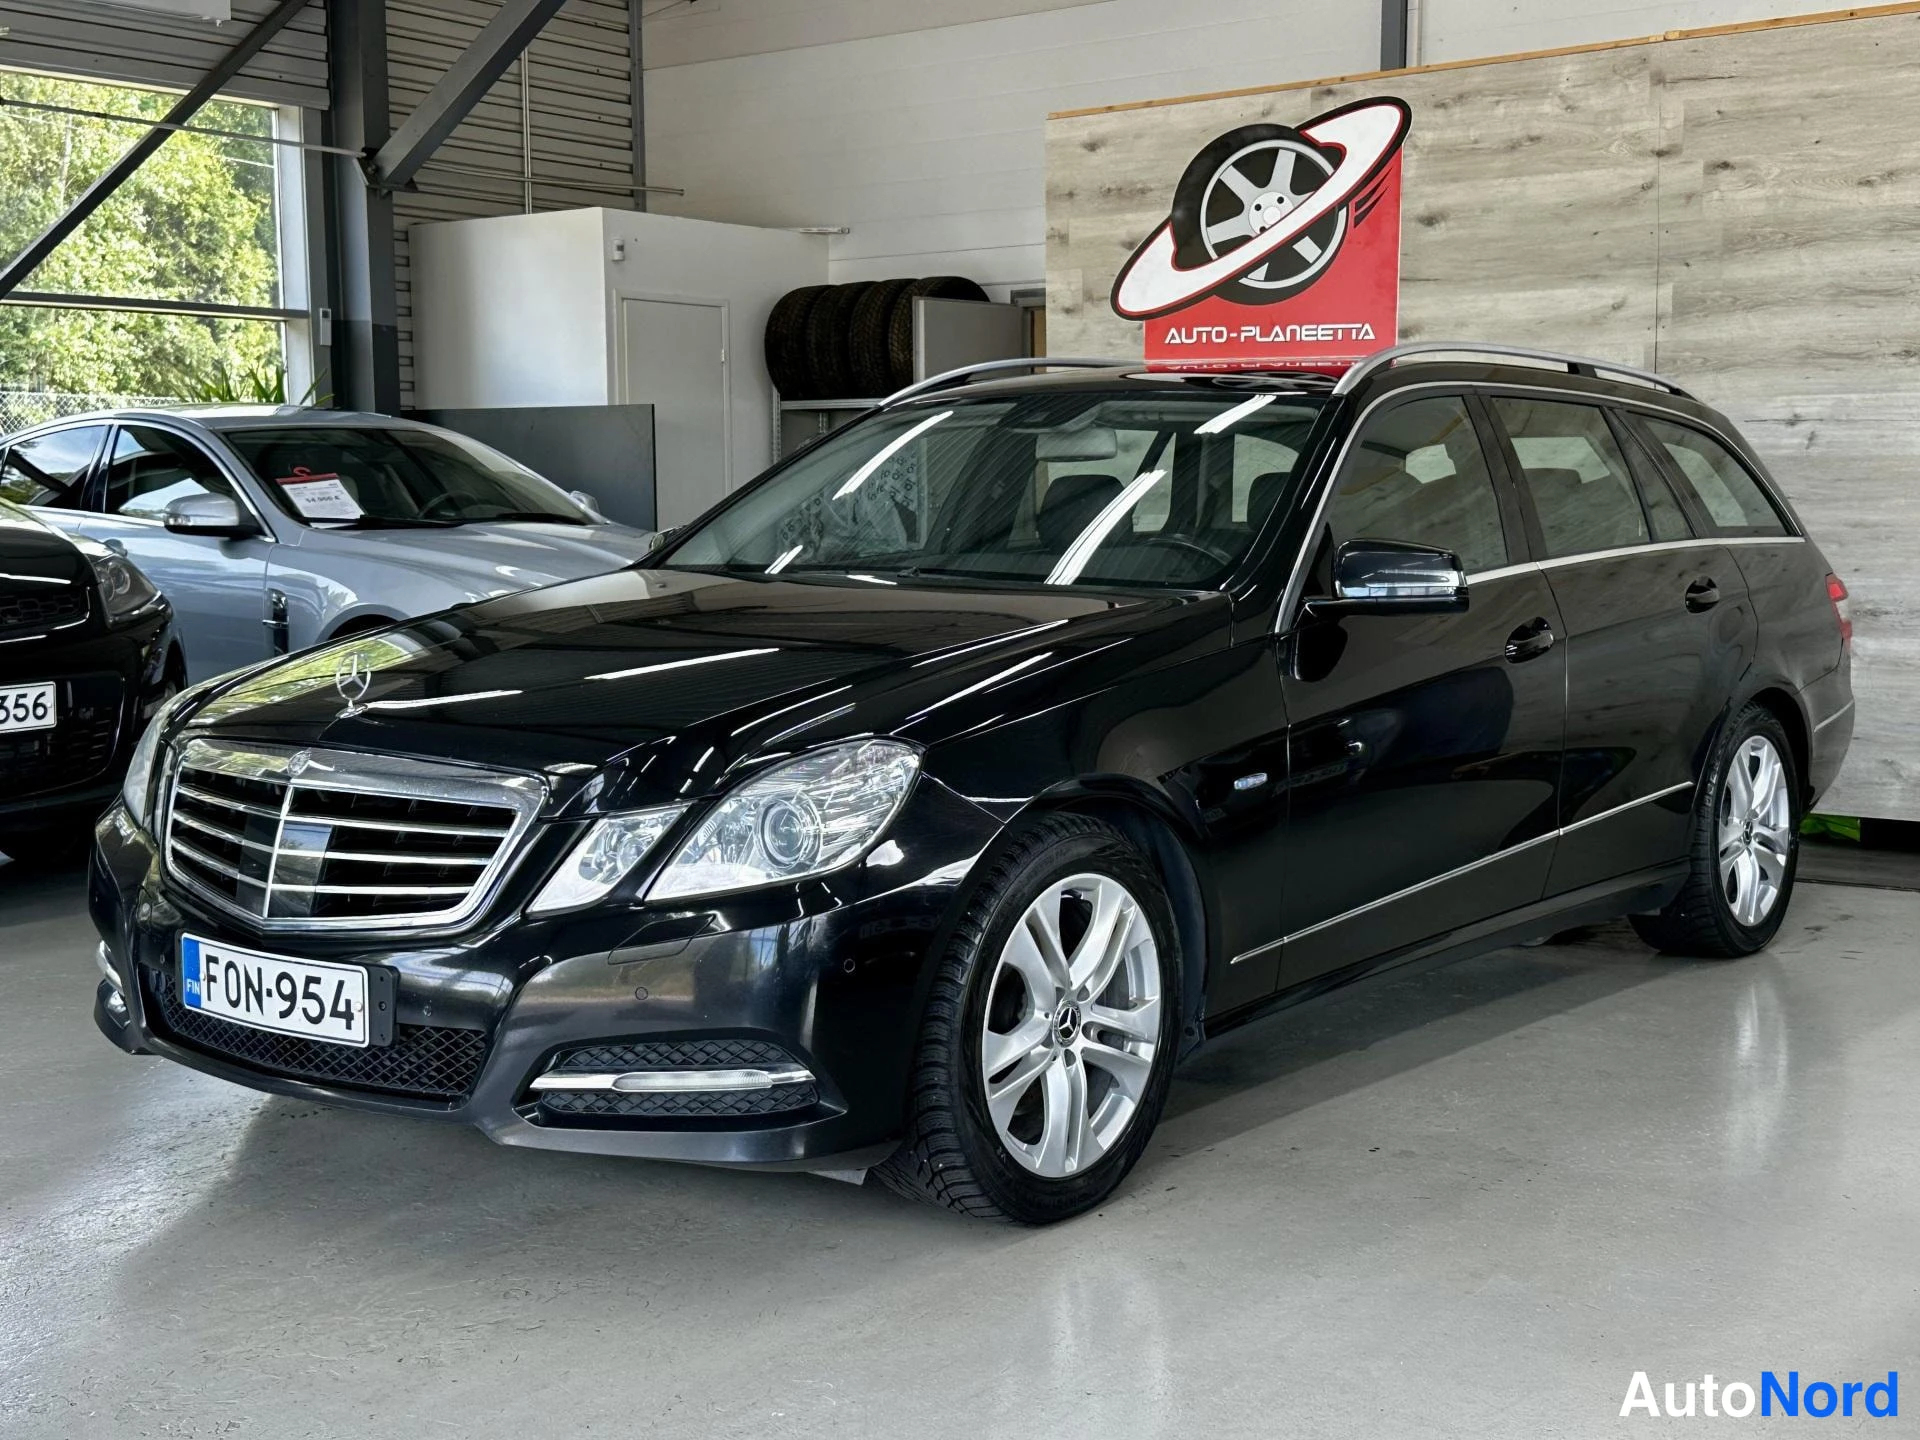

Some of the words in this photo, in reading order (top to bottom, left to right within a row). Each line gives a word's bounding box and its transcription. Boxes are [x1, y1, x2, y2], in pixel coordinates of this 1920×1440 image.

[1164, 323, 1376, 344] AUTO-PLANEETTA
[186, 978, 201, 995] FIN
[205, 954, 355, 1031] FON-954
